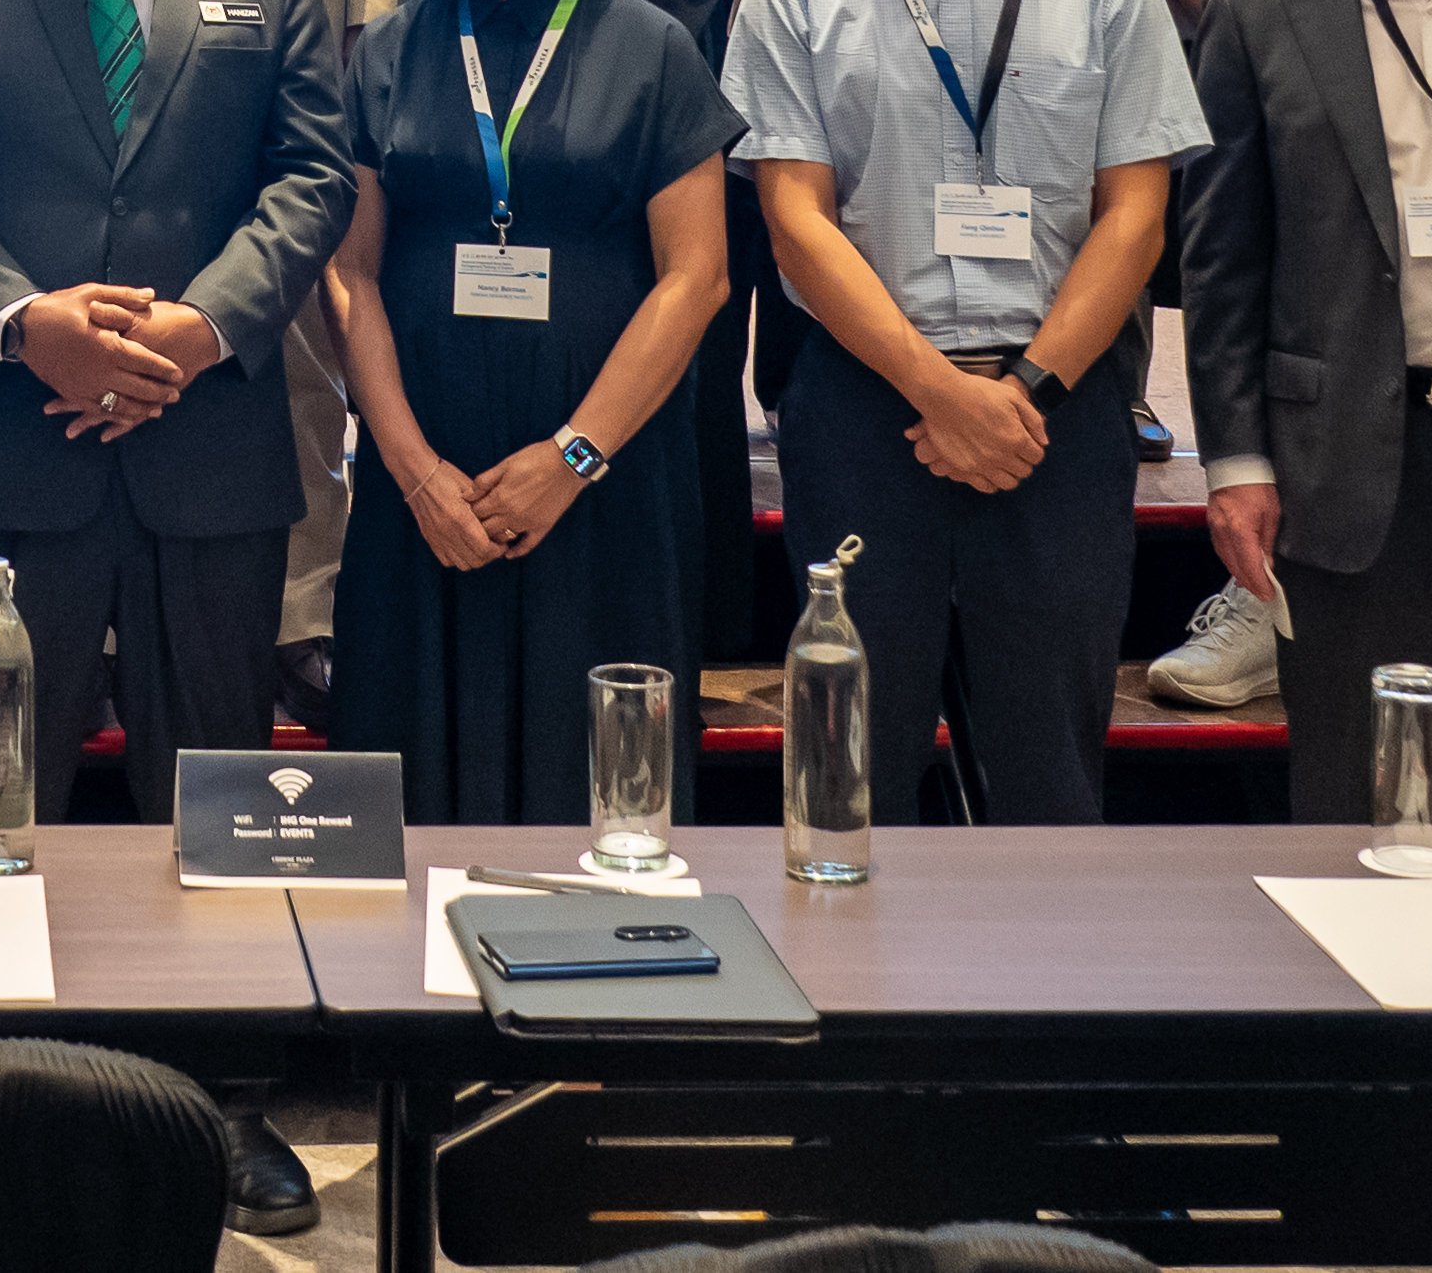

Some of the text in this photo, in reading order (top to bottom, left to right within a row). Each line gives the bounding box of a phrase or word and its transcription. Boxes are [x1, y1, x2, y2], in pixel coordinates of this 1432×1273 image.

[469, 56, 478, 87] PEMSEA
[534, 48, 549, 78] PEMSEA
[299, 816, 318, 826] One
[319, 816, 352, 827] Reward
[233, 829, 272, 839] Password
[280, 829, 314, 839] EVENTS
